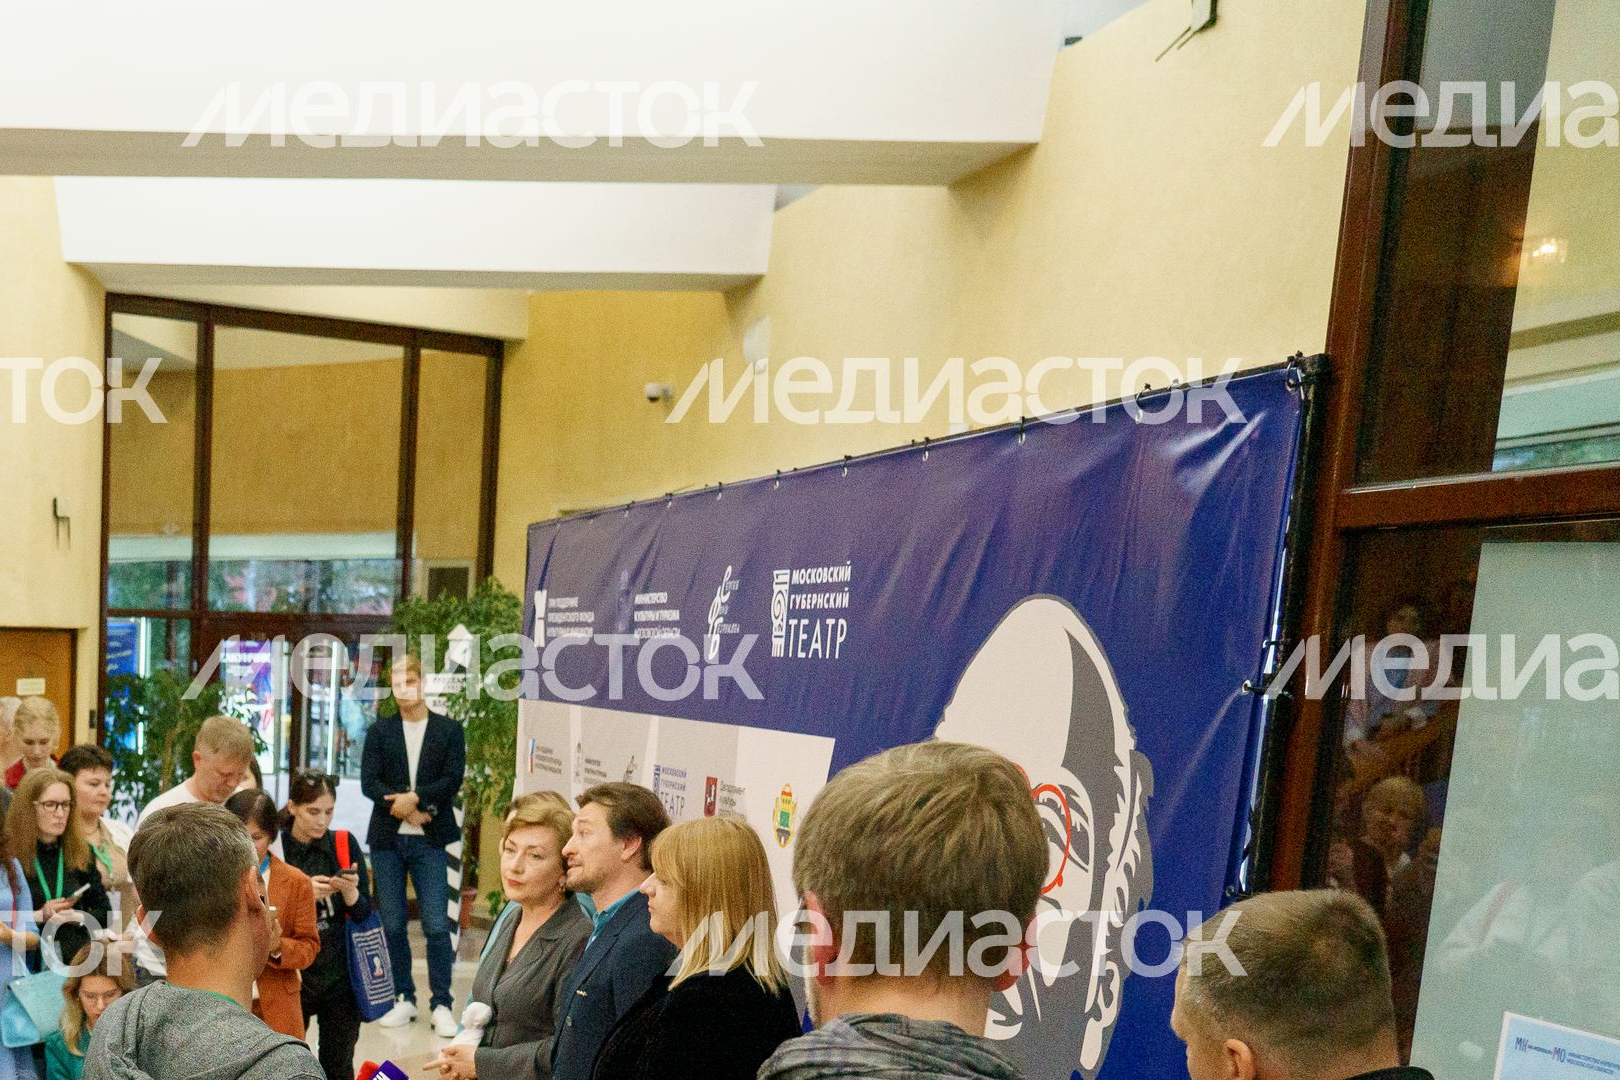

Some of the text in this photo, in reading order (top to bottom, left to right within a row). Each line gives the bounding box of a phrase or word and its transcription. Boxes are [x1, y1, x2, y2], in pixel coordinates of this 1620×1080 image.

[791, 561, 851, 585] МОСКОВСКИЙ
[790, 587, 849, 609] ГУБЕРНСКИЙ
[788, 618, 848, 659] ТЕАТР
